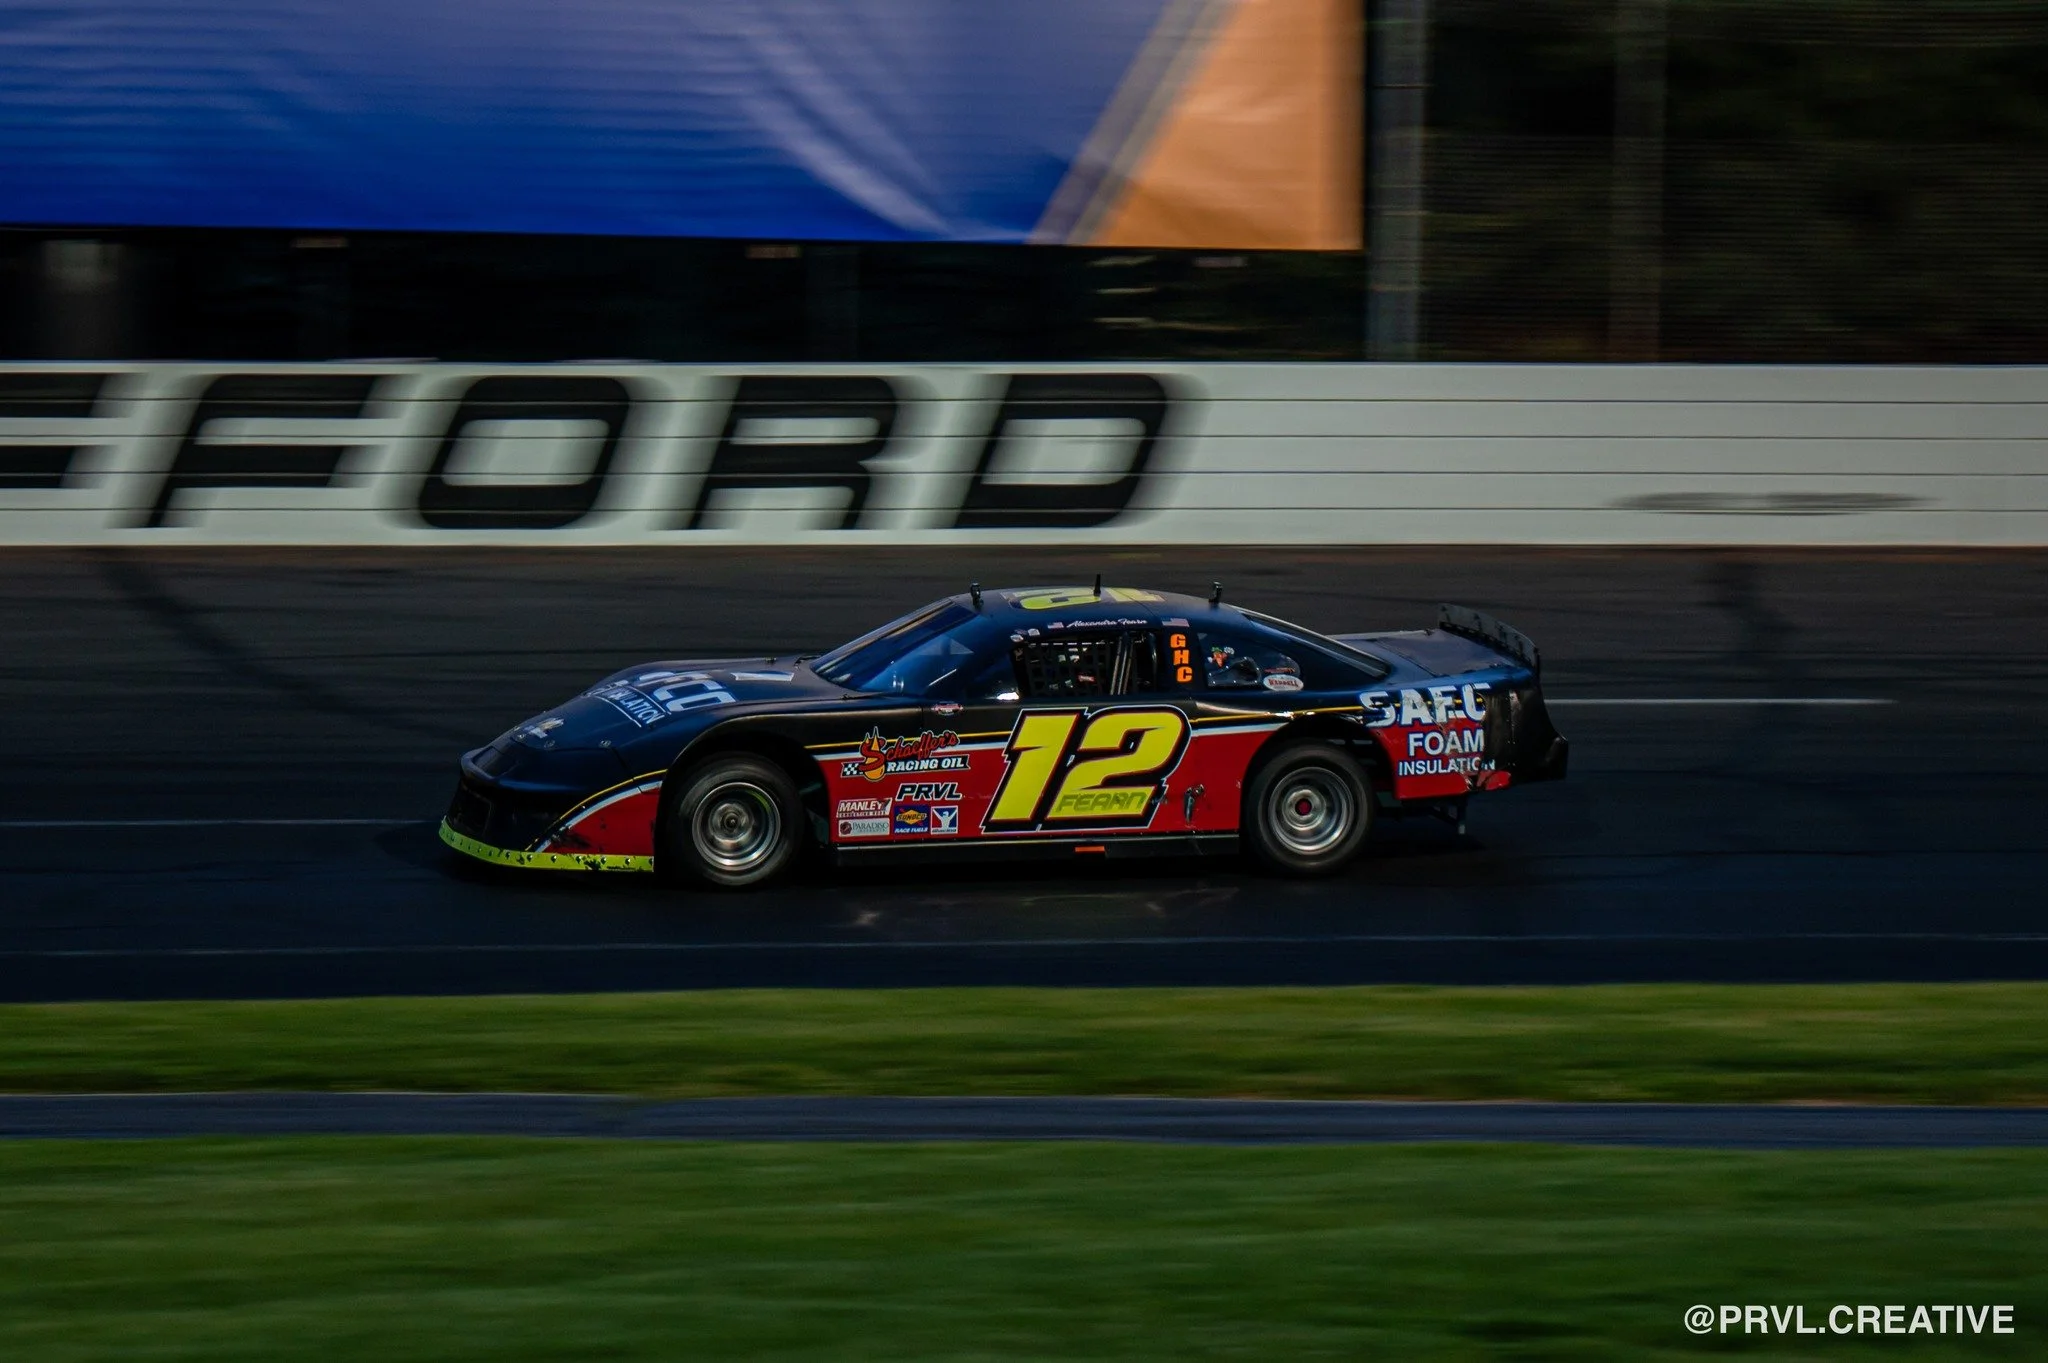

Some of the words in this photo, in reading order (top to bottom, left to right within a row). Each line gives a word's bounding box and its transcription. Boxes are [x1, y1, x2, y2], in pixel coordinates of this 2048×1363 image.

[859, 730, 960, 772] Schaeffer's
[1408, 728, 1484, 757] FOAM
[886, 758, 938, 772] RACING
[940, 757, 965, 768] OIL
[985, 707, 1188, 828] 12
[895, 782, 963, 802] PRVL
[839, 800, 882, 811] MANLEY
[897, 812, 928, 821] SUNOCO
